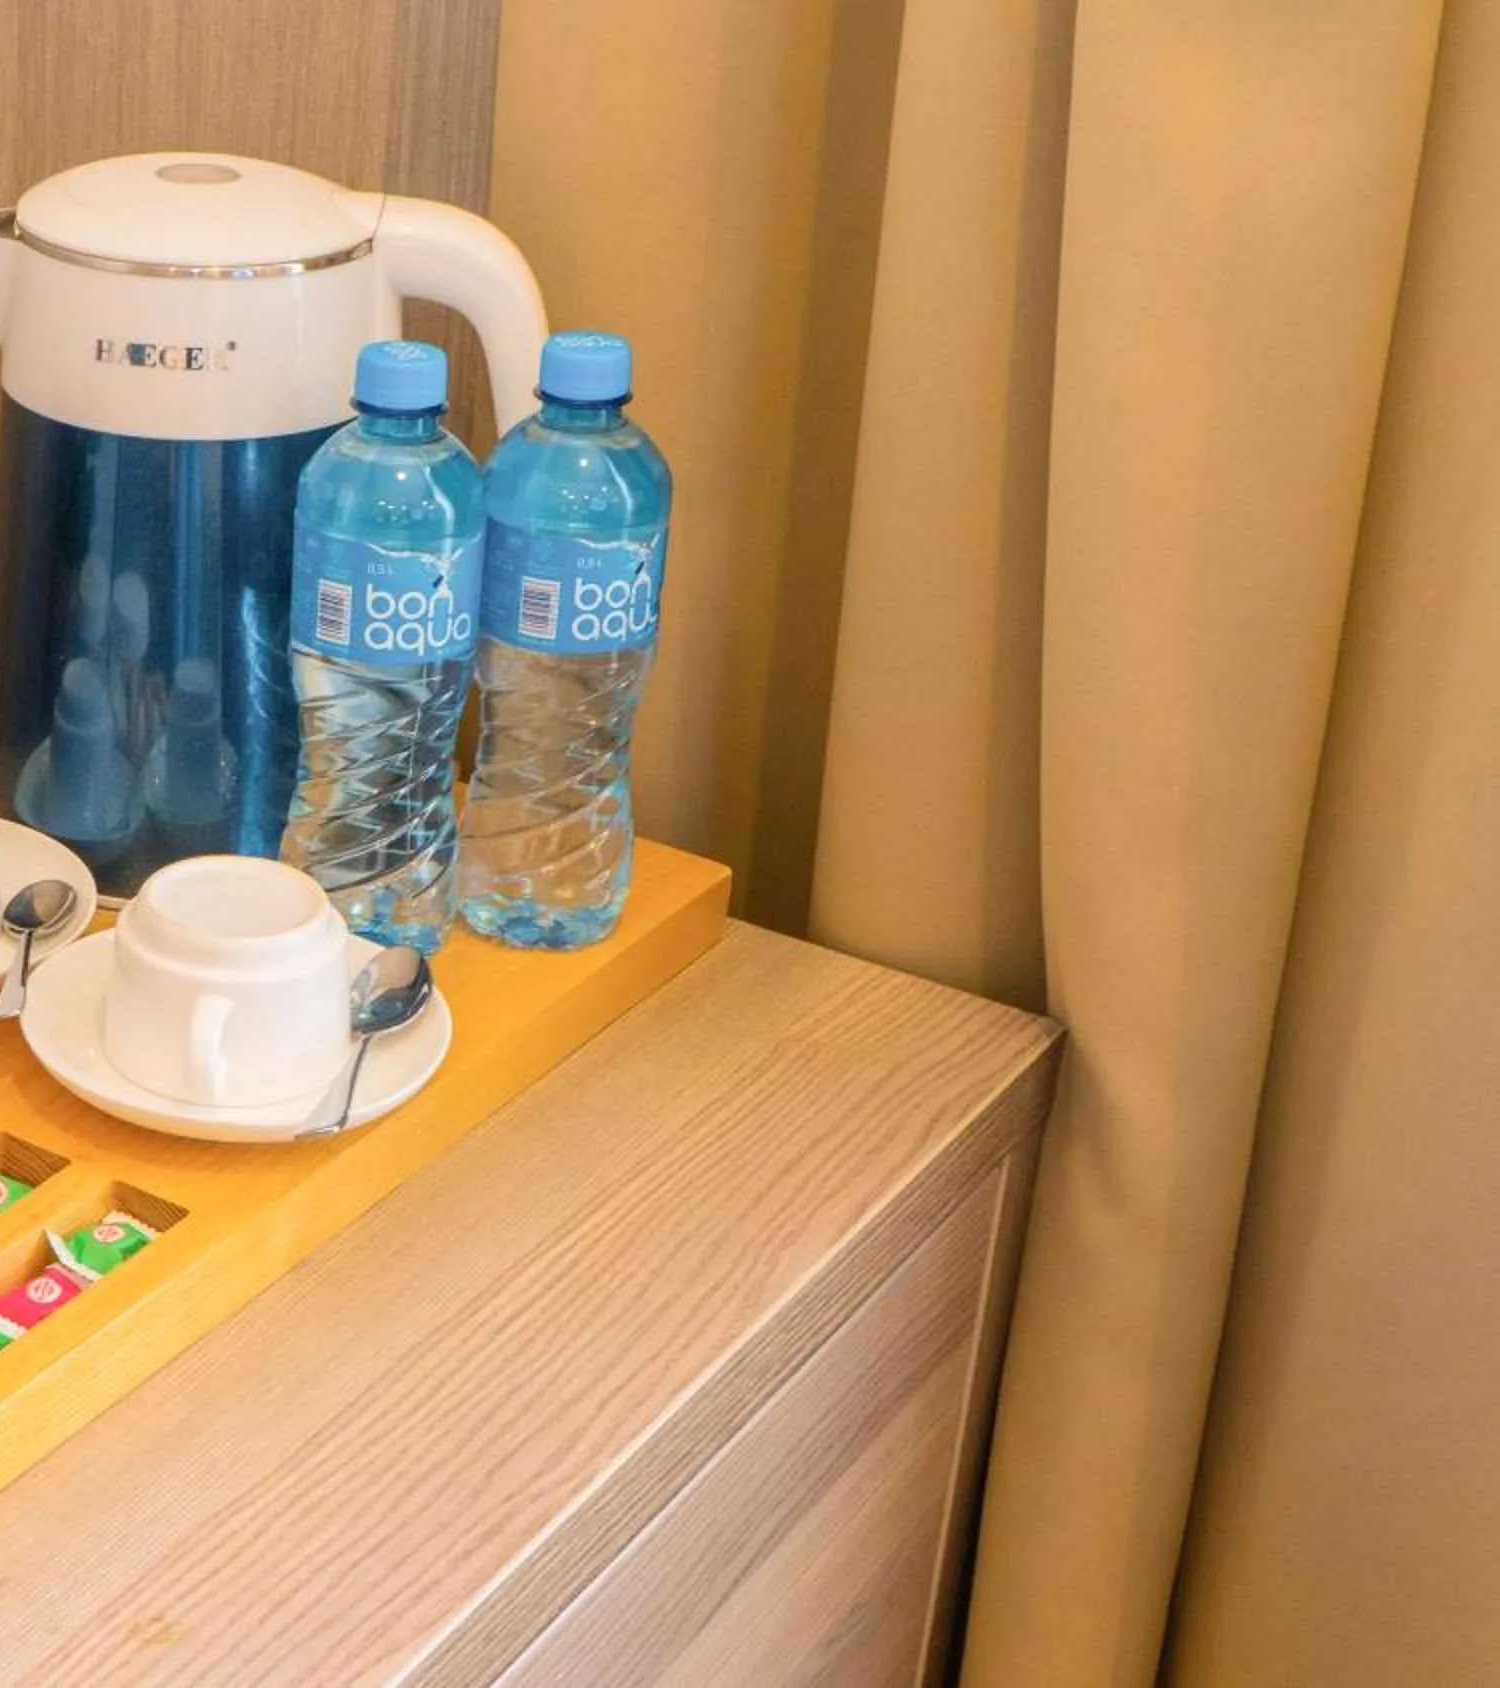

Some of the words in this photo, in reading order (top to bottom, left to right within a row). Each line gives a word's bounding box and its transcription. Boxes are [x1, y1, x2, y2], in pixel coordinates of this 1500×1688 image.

[365, 583, 453, 619] bon
[574, 575, 651, 611] bon
[363, 612, 471, 656] aqua
[571, 602, 656, 642] aqu
